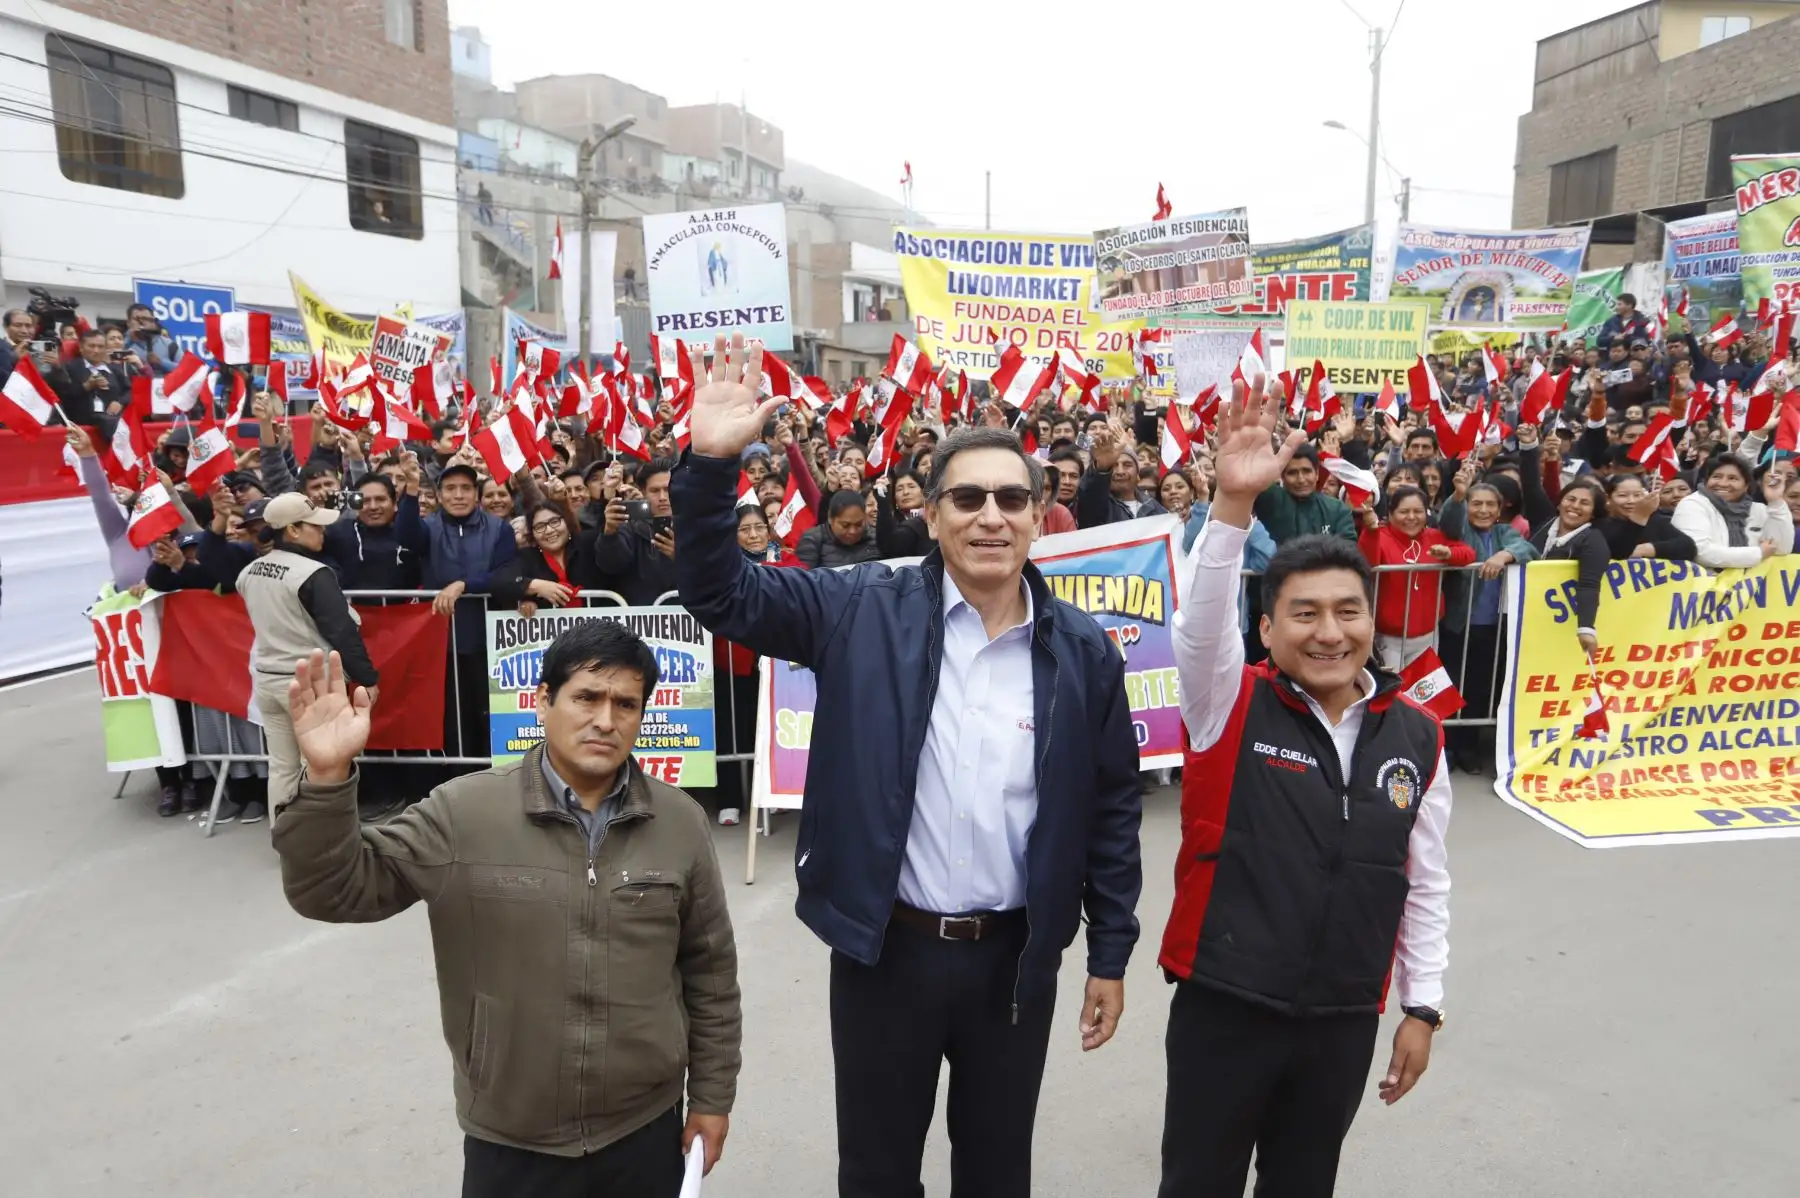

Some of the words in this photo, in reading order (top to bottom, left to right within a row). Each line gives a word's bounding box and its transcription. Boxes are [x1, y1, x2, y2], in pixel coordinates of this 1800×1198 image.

[650, 223, 713, 271] INMACULADA
[715, 222, 782, 260] CONCEPCIÓN
[1098, 224, 1167, 254] ASOCIACIÓN
[1171, 218, 1247, 236] RESIDENCIAL
[1446, 235, 1505, 250] POPULAR
[1506, 239, 1522, 250] DE
[1523, 235, 1577, 249] VIVIENDA
[895, 231, 1022, 265] ASOCIACION
[1029, 242, 1054, 267] DE
[1143, 256, 1174, 269] CEDROS
[1177, 253, 1187, 264] DE
[1190, 249, 1217, 263] SANTA
[1220, 242, 1247, 258] CLARA
[1460, 253, 1483, 266] DE
[948, 271, 1081, 301] LIVOMARKET
[1104, 298, 1138, 311] FUNDADO
[1165, 293, 1175, 304] DE
[1176, 286, 1210, 302] OCTUBRE
[1213, 284, 1226, 296] DEL
[656, 305, 784, 332] PRESENTE
[955, 302, 1056, 325] FUNDADA
[1063, 309, 1088, 326] EL
[1324, 308, 1364, 330] COOP.
[1368, 309, 1386, 330] DE
[1390, 310, 1415, 331] VIV.
[1510, 303, 1566, 314] PRESENTE
[916, 316, 944, 340] DE
[1037, 328, 1087, 350] DEL
[376, 334, 426, 367] AMAUTA
[1291, 337, 1328, 358] RAMIRO
[1331, 338, 1362, 359] PRIALE
[1364, 339, 1376, 359] DE
[1377, 340, 1395, 360] ATE
[1300, 367, 1404, 385] PESENTE
[626, 613, 705, 645] VIVIENDA
[1586, 644, 1616, 666] EL
[1525, 675, 1560, 693] EL
[1540, 699, 1572, 718] EL
[1708, 671, 1800, 694] RONC
[654, 689, 680, 706] ATE
[656, 713, 668, 723] DE
[1530, 728, 1560, 748] TE
[1253, 742, 1278, 756] EDDE
[1280, 748, 1318, 767] CUELLAR
[1265, 756, 1307, 774] ALCALDE
[1543, 748, 1561, 766] A
[1522, 773, 1548, 793] TE
[1700, 759, 1760, 782] POR
